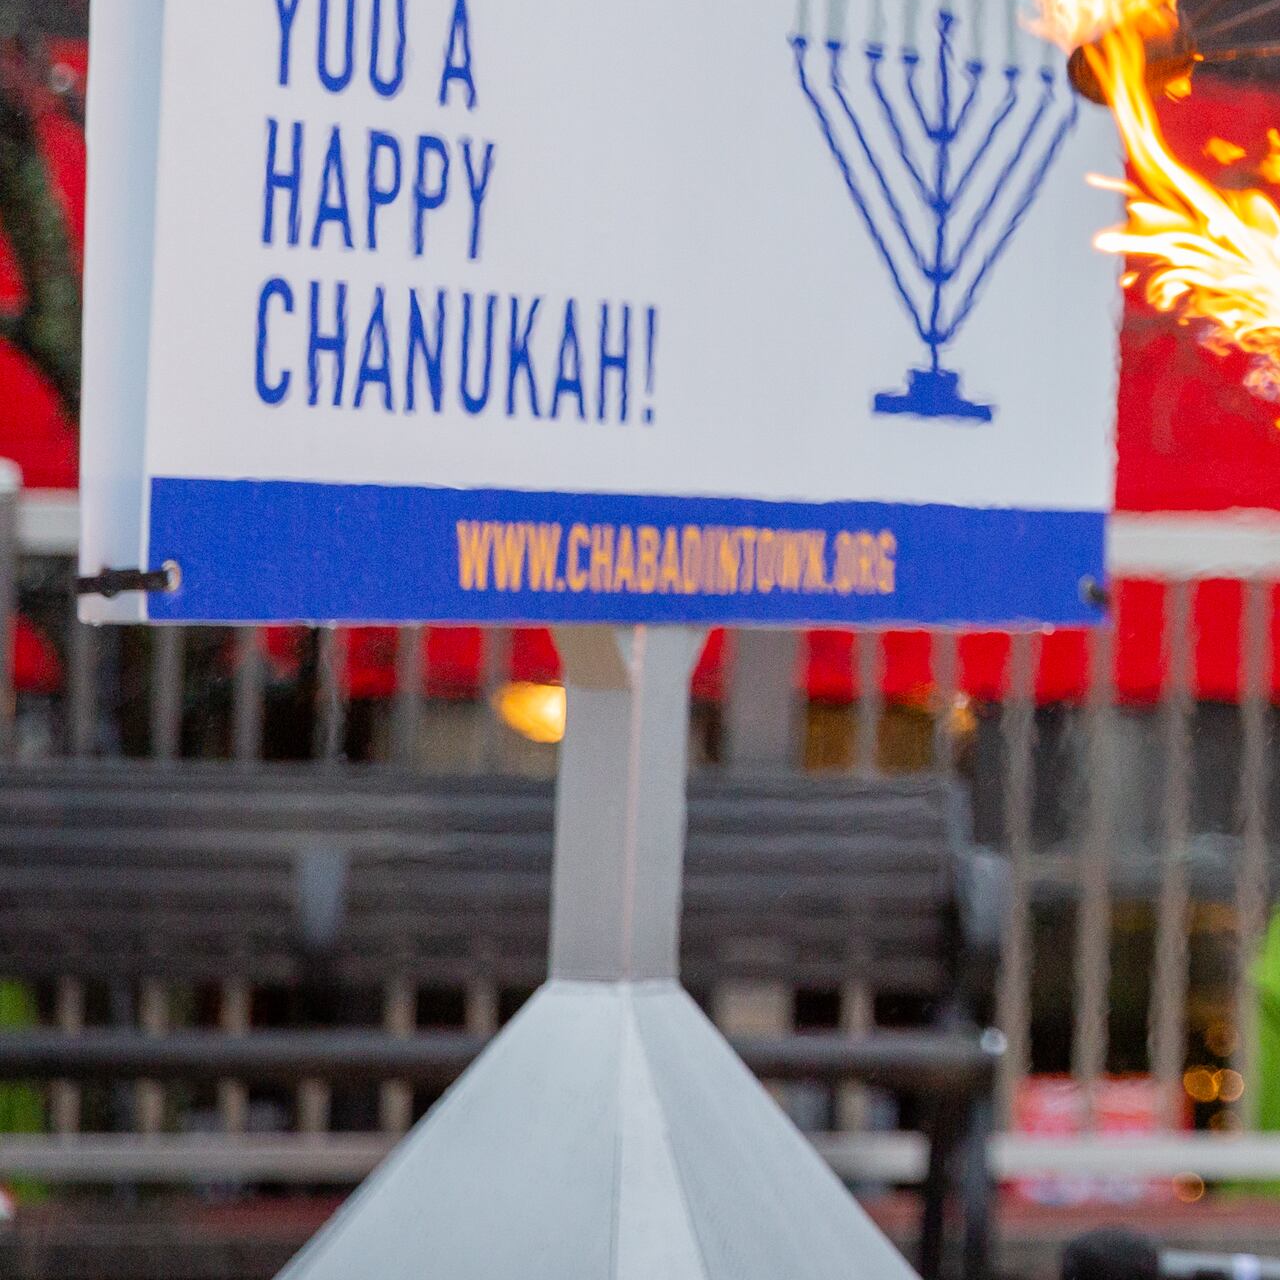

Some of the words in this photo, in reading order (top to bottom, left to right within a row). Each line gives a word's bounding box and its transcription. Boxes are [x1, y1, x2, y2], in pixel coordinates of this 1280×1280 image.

[260, 118, 495, 260] HAPPY
[254, 276, 657, 423] CHANUKAH!
[456, 519, 896, 595] WWW.CHABADINTOWN.ORG
